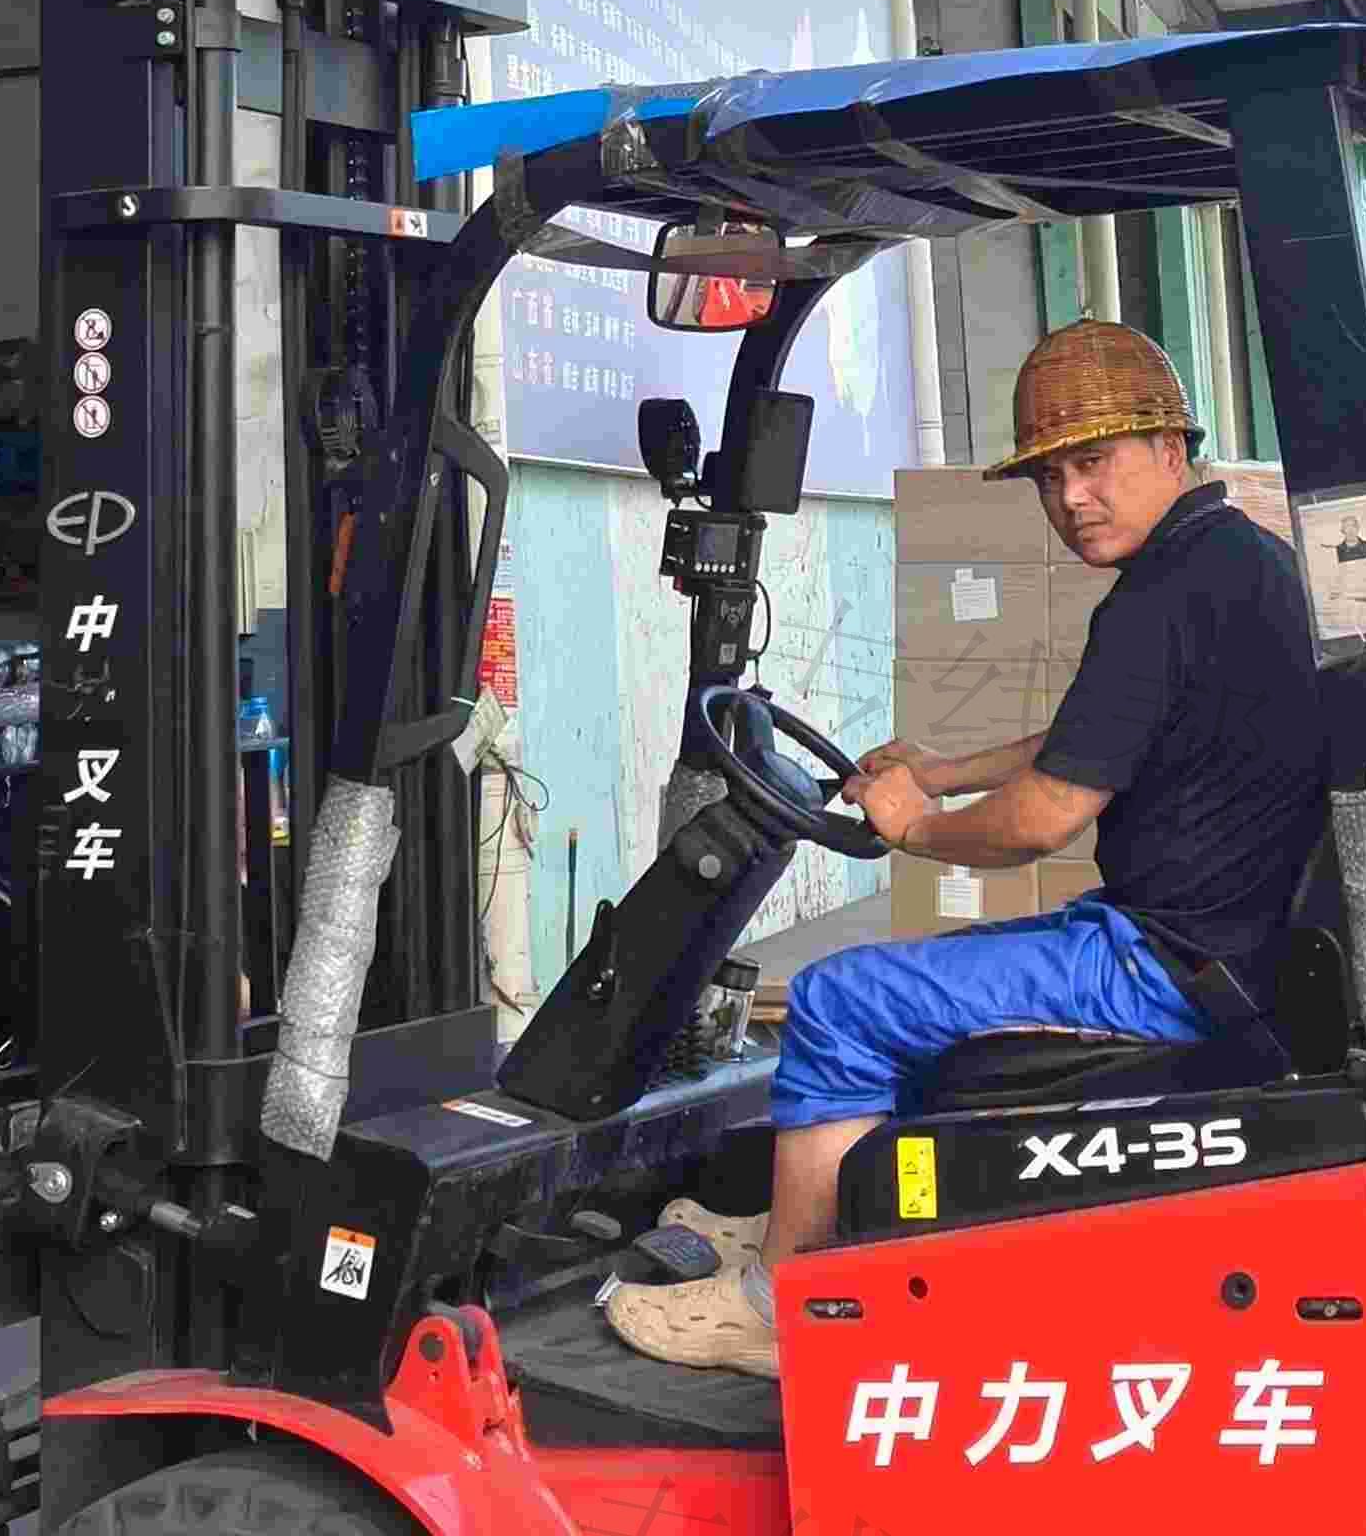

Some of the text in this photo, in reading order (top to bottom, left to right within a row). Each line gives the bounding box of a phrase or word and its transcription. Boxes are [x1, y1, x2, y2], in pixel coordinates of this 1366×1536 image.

[63, 594, 123, 880] 中叉车
[1017, 1117, 1248, 1180] X4-35
[845, 1358, 1326, 1468] 中力叉车
